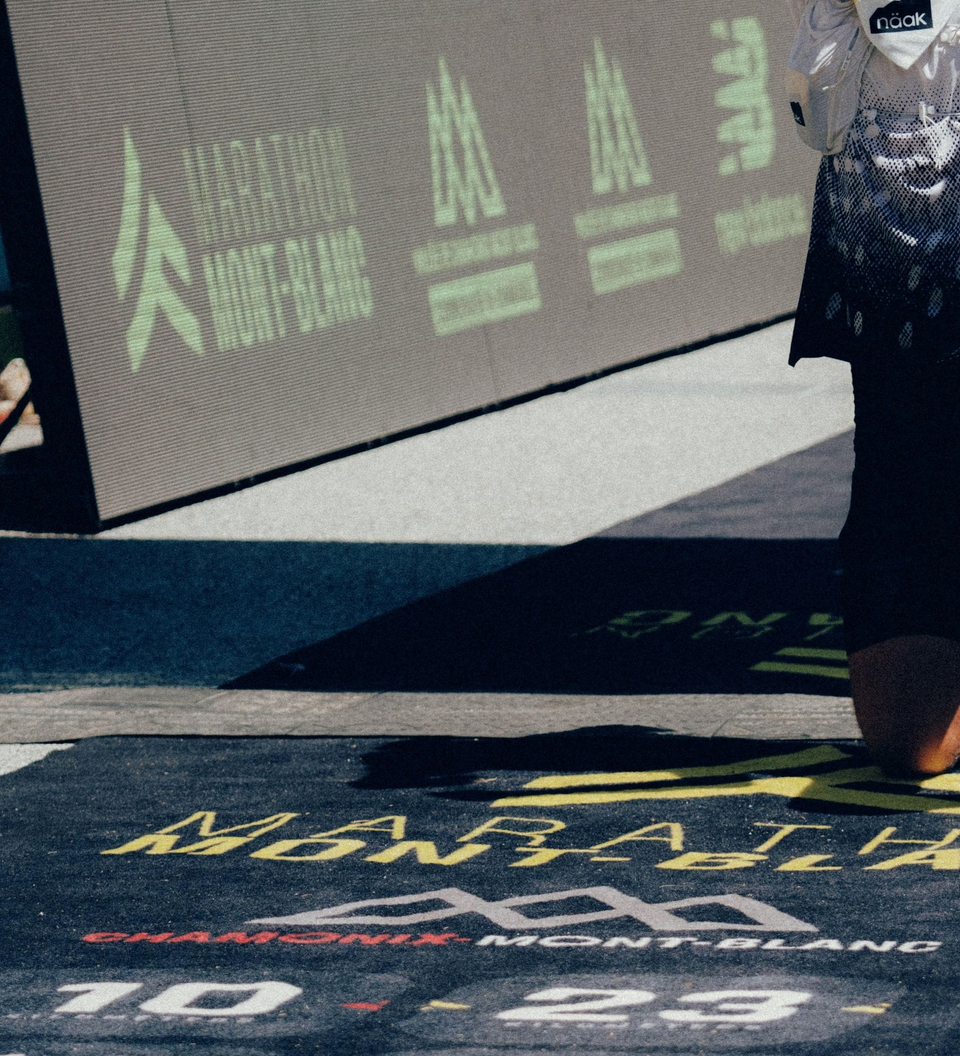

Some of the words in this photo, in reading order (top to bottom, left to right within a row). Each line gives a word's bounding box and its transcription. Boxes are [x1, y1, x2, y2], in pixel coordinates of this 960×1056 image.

[876, 11, 928, 30] näak
[183, 126, 358, 244] MARATHON
[203, 225, 375, 352] MONT-BLANC
[53, 980, 303, 1015] 10
[496, 986, 813, 1023] 23
